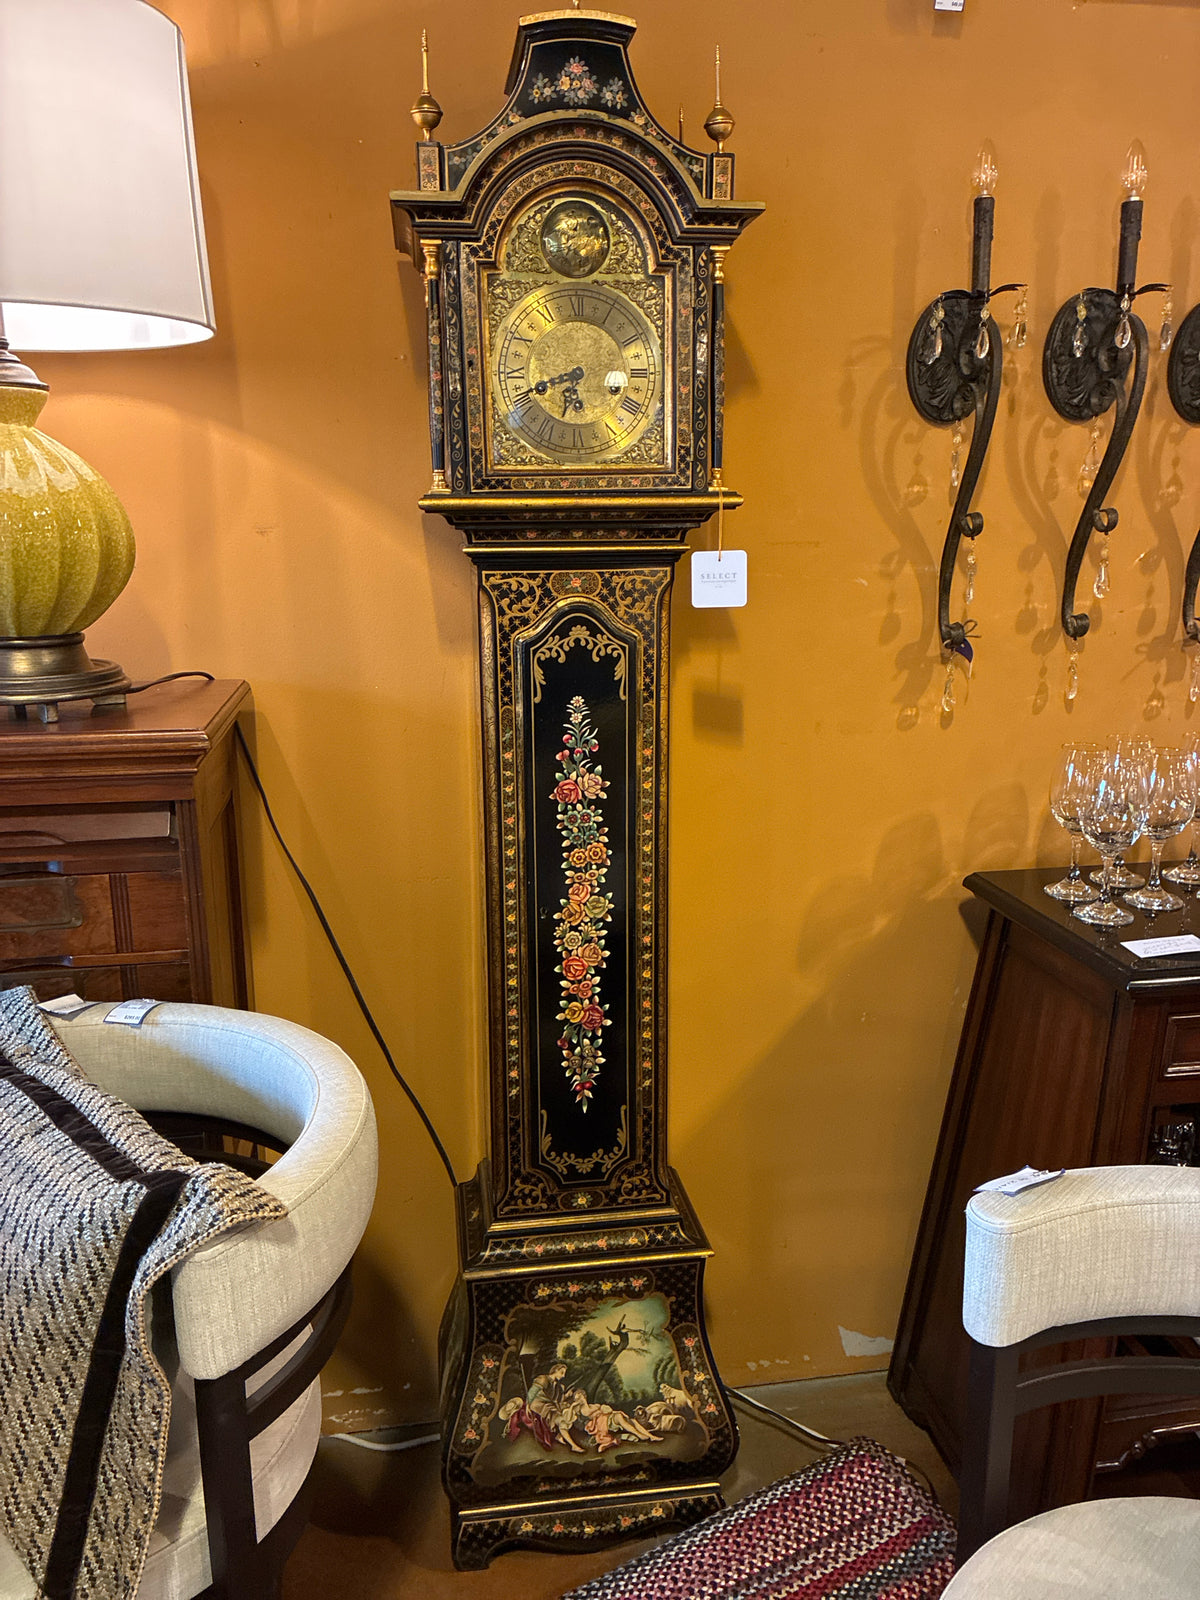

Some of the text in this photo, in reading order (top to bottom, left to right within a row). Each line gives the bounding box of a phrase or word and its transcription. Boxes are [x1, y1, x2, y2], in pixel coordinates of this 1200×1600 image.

[568, 296, 584, 317] XII
[535, 303, 555, 327] XI
[513, 330, 533, 349] X
[622, 333, 640, 348] II
[506, 366, 525, 379] IX
[630, 368, 648, 378] III
[701, 572, 737, 580] SELECT
